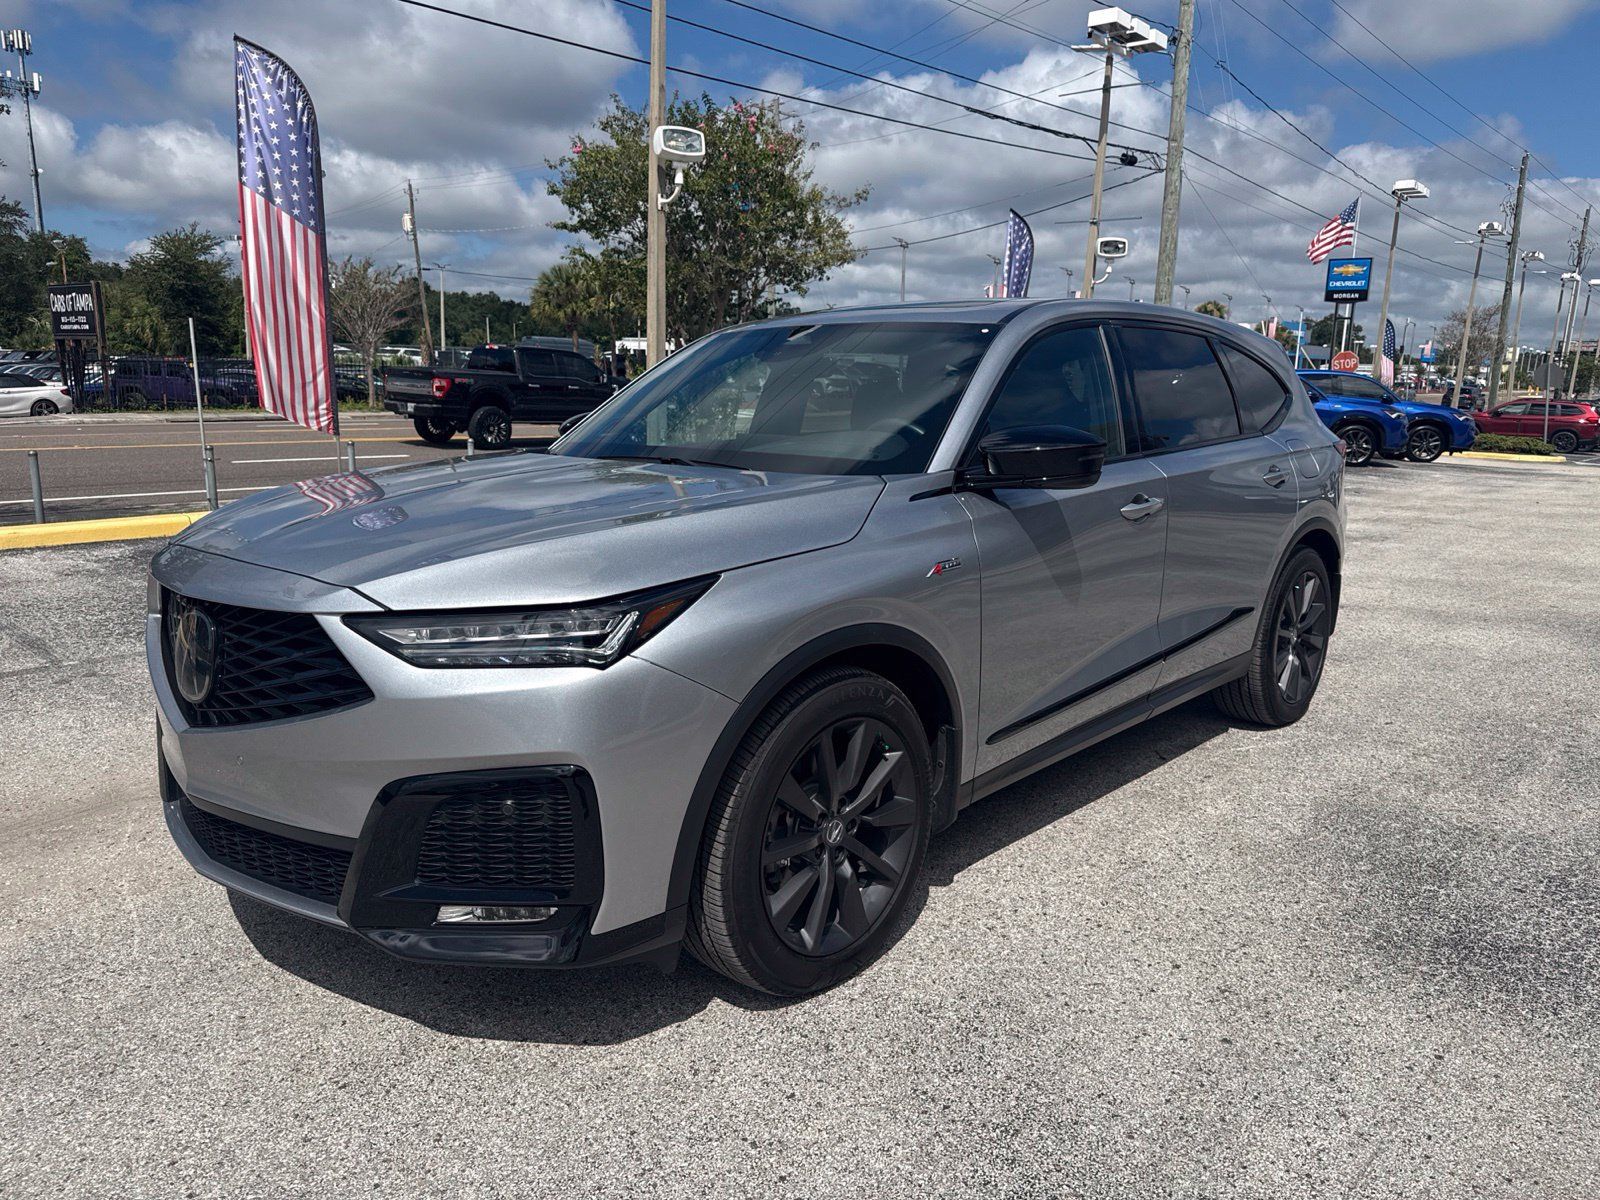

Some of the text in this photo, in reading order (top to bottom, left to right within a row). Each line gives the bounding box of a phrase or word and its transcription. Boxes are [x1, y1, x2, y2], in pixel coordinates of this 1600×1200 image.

[50, 292, 93, 312] CARS OF TAMPA
[1334, 358, 1357, 370] STOP
